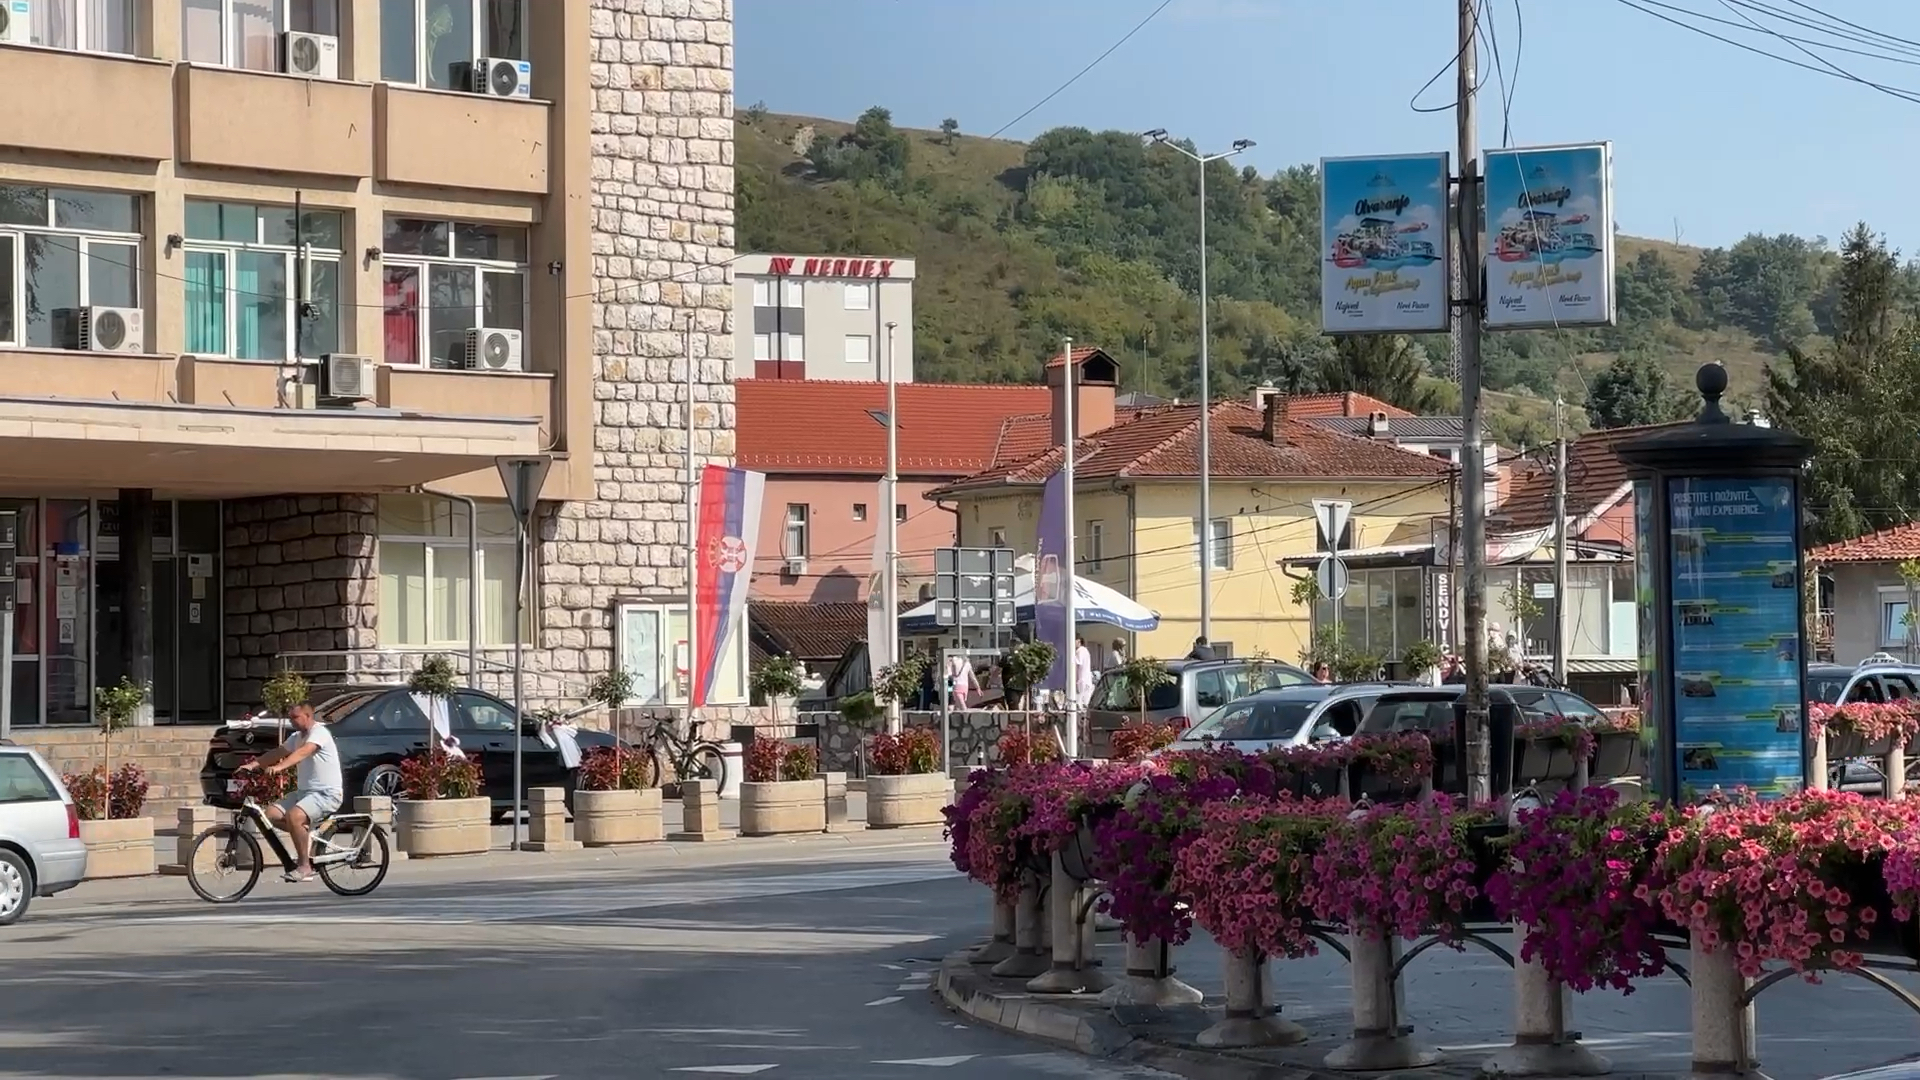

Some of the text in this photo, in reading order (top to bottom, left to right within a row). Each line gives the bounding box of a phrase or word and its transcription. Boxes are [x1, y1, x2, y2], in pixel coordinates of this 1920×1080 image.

[804, 258, 894, 278] NERNEX
[1673, 492, 1709, 503] POSETITE
[1694, 505, 1711, 517] AND
